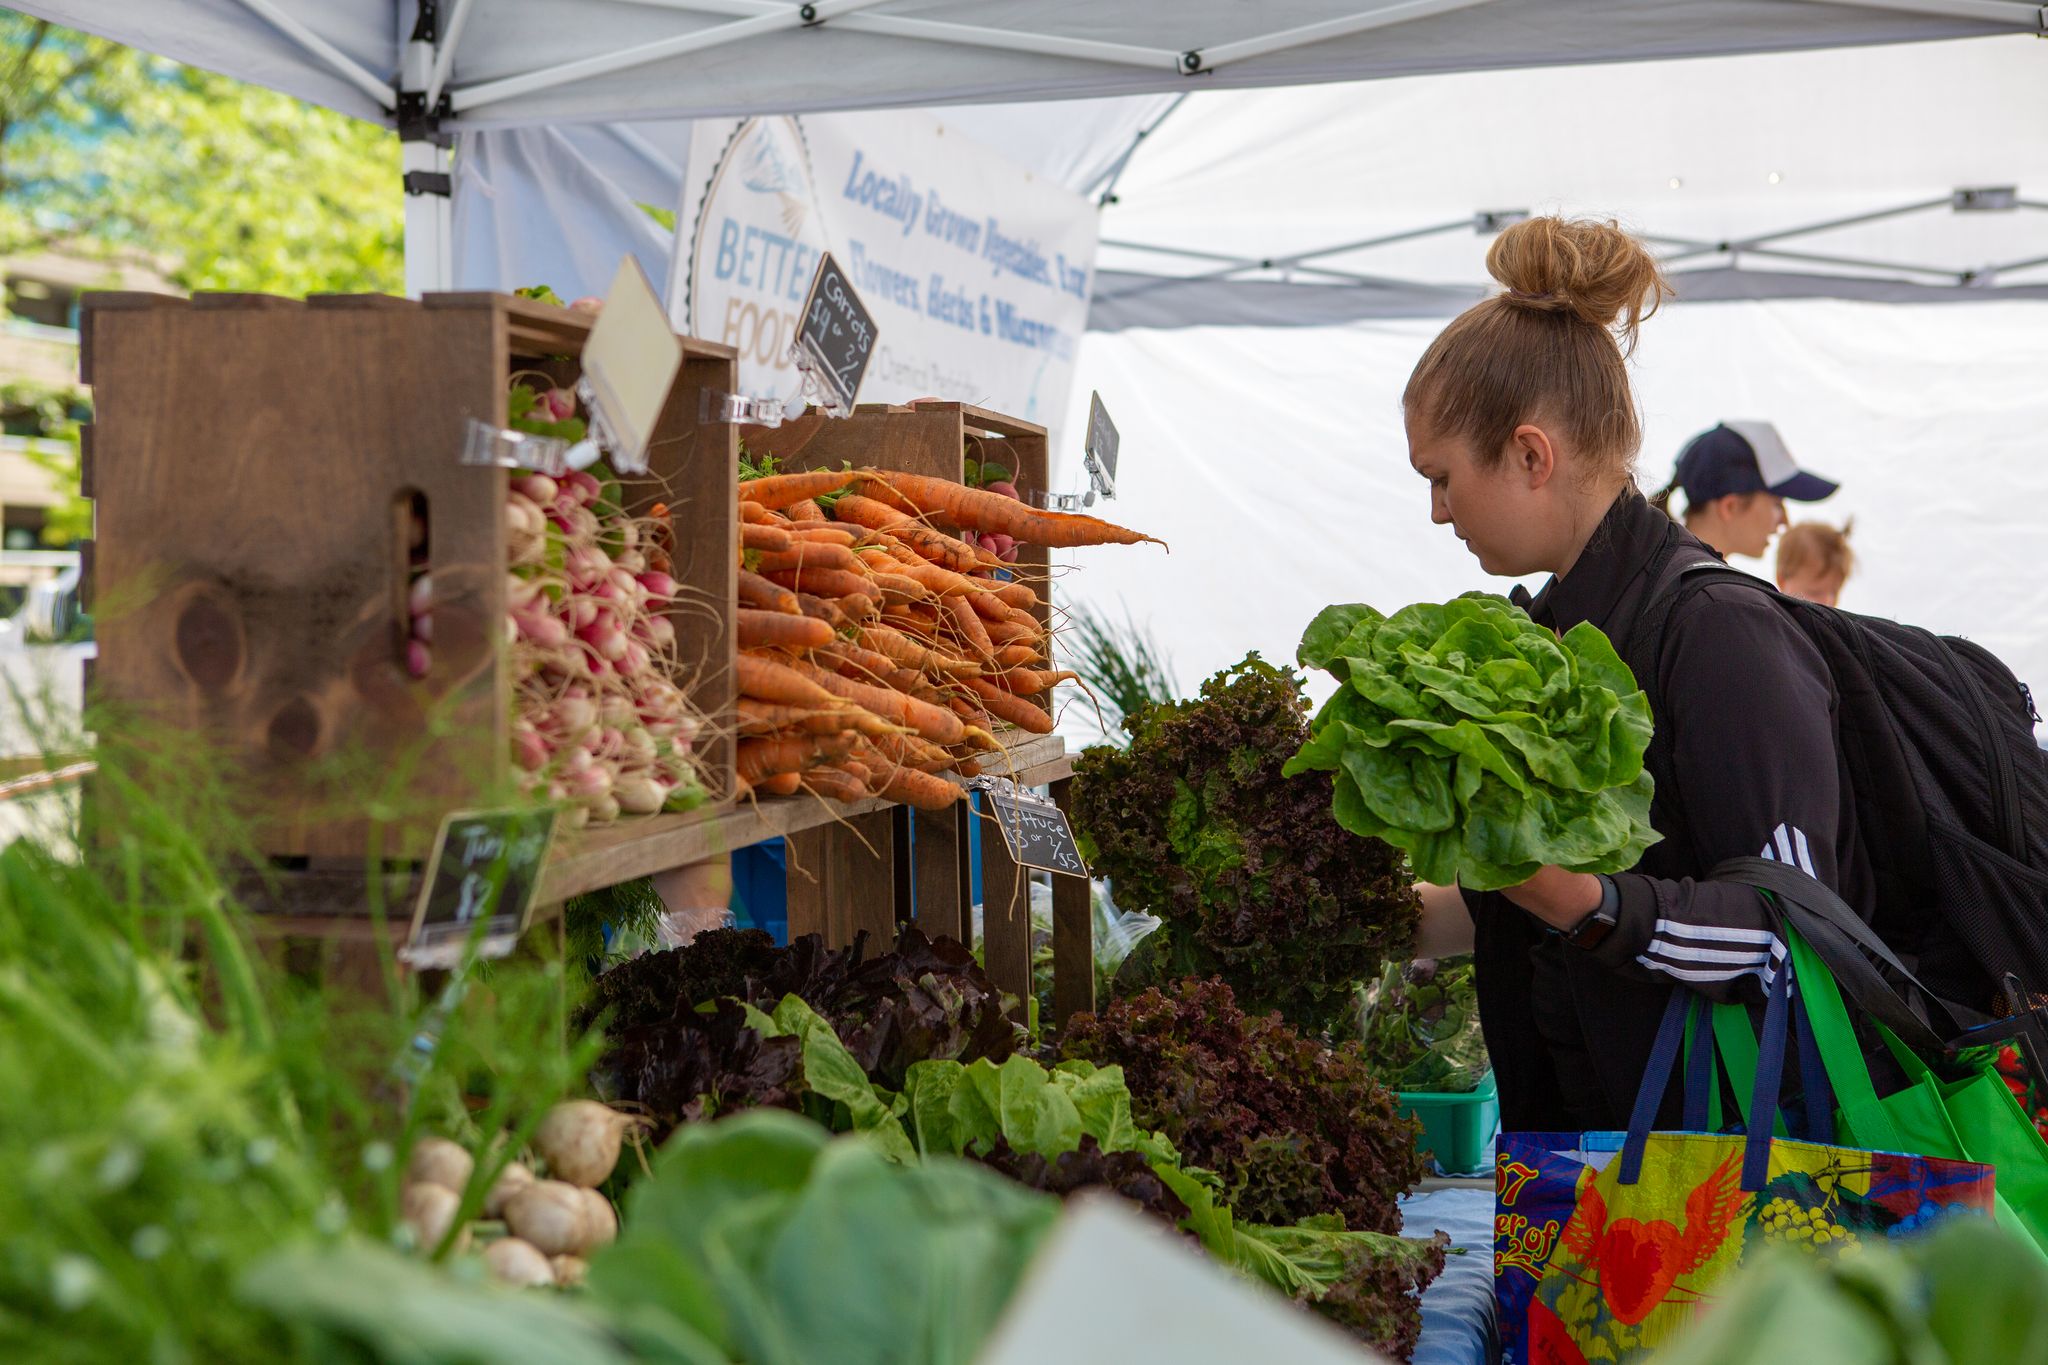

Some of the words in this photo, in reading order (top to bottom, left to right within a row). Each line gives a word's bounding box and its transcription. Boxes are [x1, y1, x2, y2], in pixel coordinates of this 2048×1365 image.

[843, 149, 921, 237] Locally
[824, 271, 871, 354] Carrots
[1030, 833, 1043, 842] or
[1523, 1219, 1560, 1262] of
